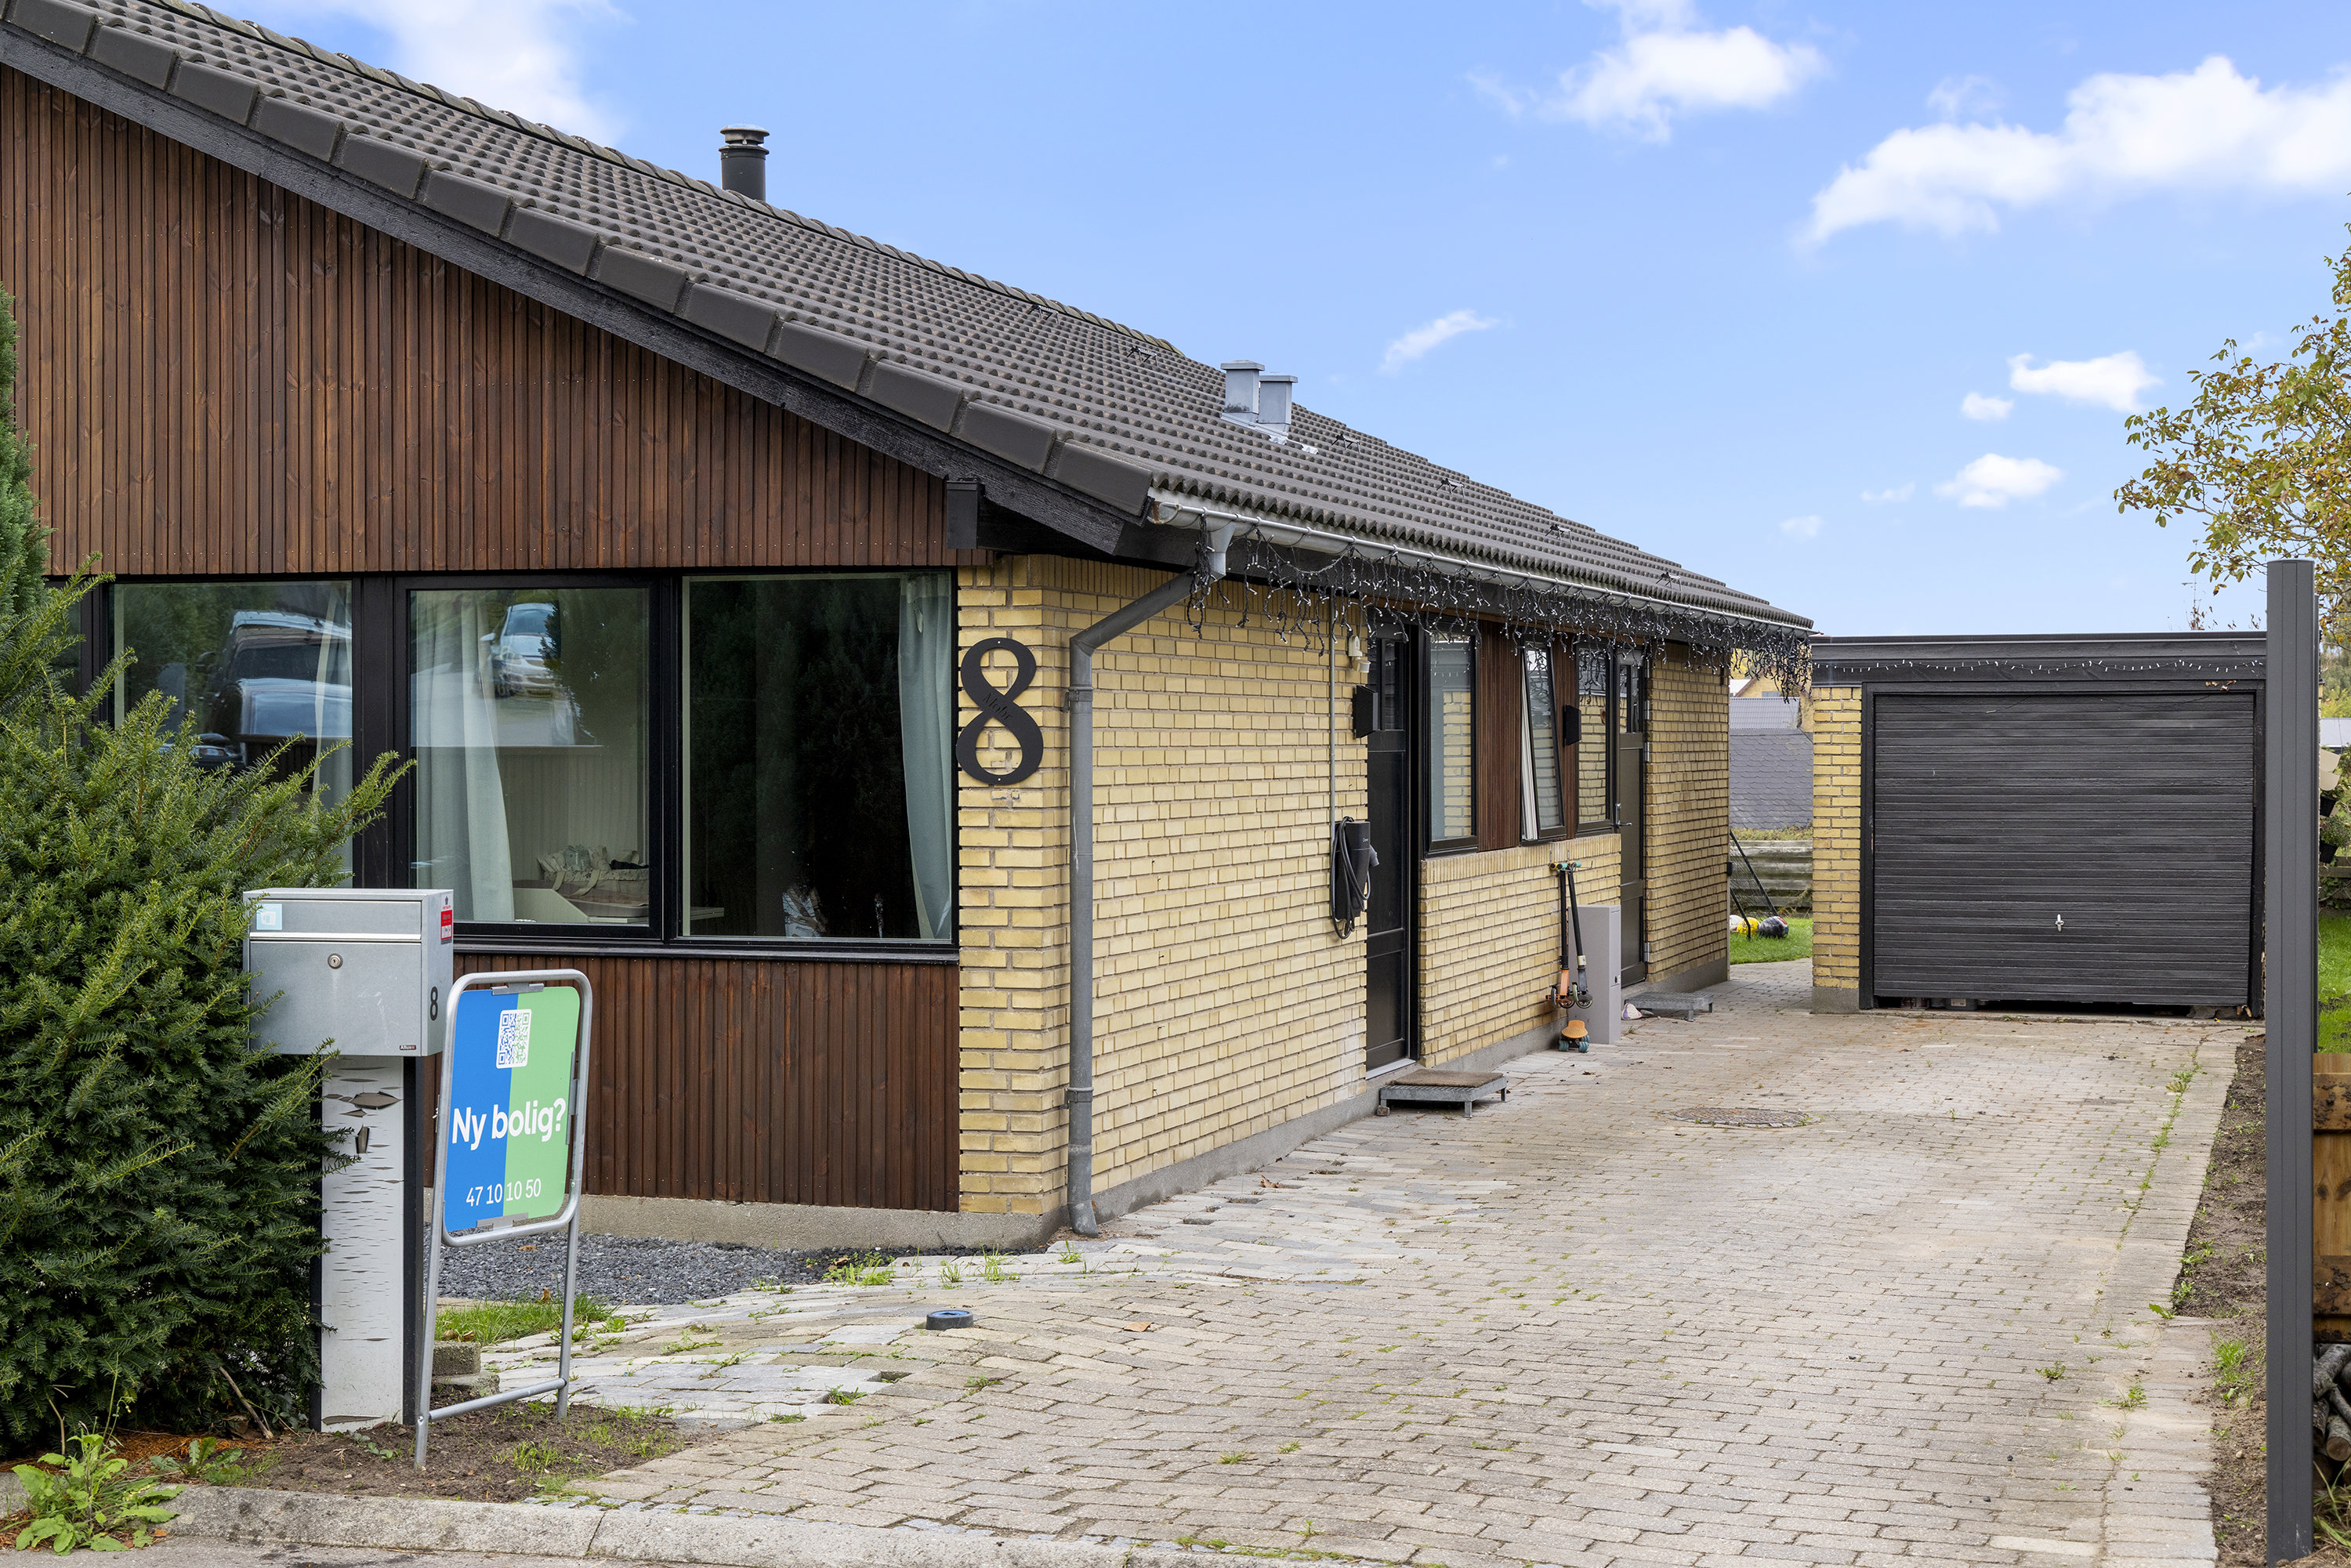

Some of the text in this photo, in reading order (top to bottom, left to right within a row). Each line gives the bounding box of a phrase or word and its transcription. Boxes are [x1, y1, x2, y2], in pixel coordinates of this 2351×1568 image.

[955, 637, 1043, 784] 8
[983, 692, 1012, 720] Mohr
[430, 987, 438, 1020] 8
[452, 1098, 566, 1150] Ny bolig?
[465, 1179, 541, 1207] 47 10 10 50
